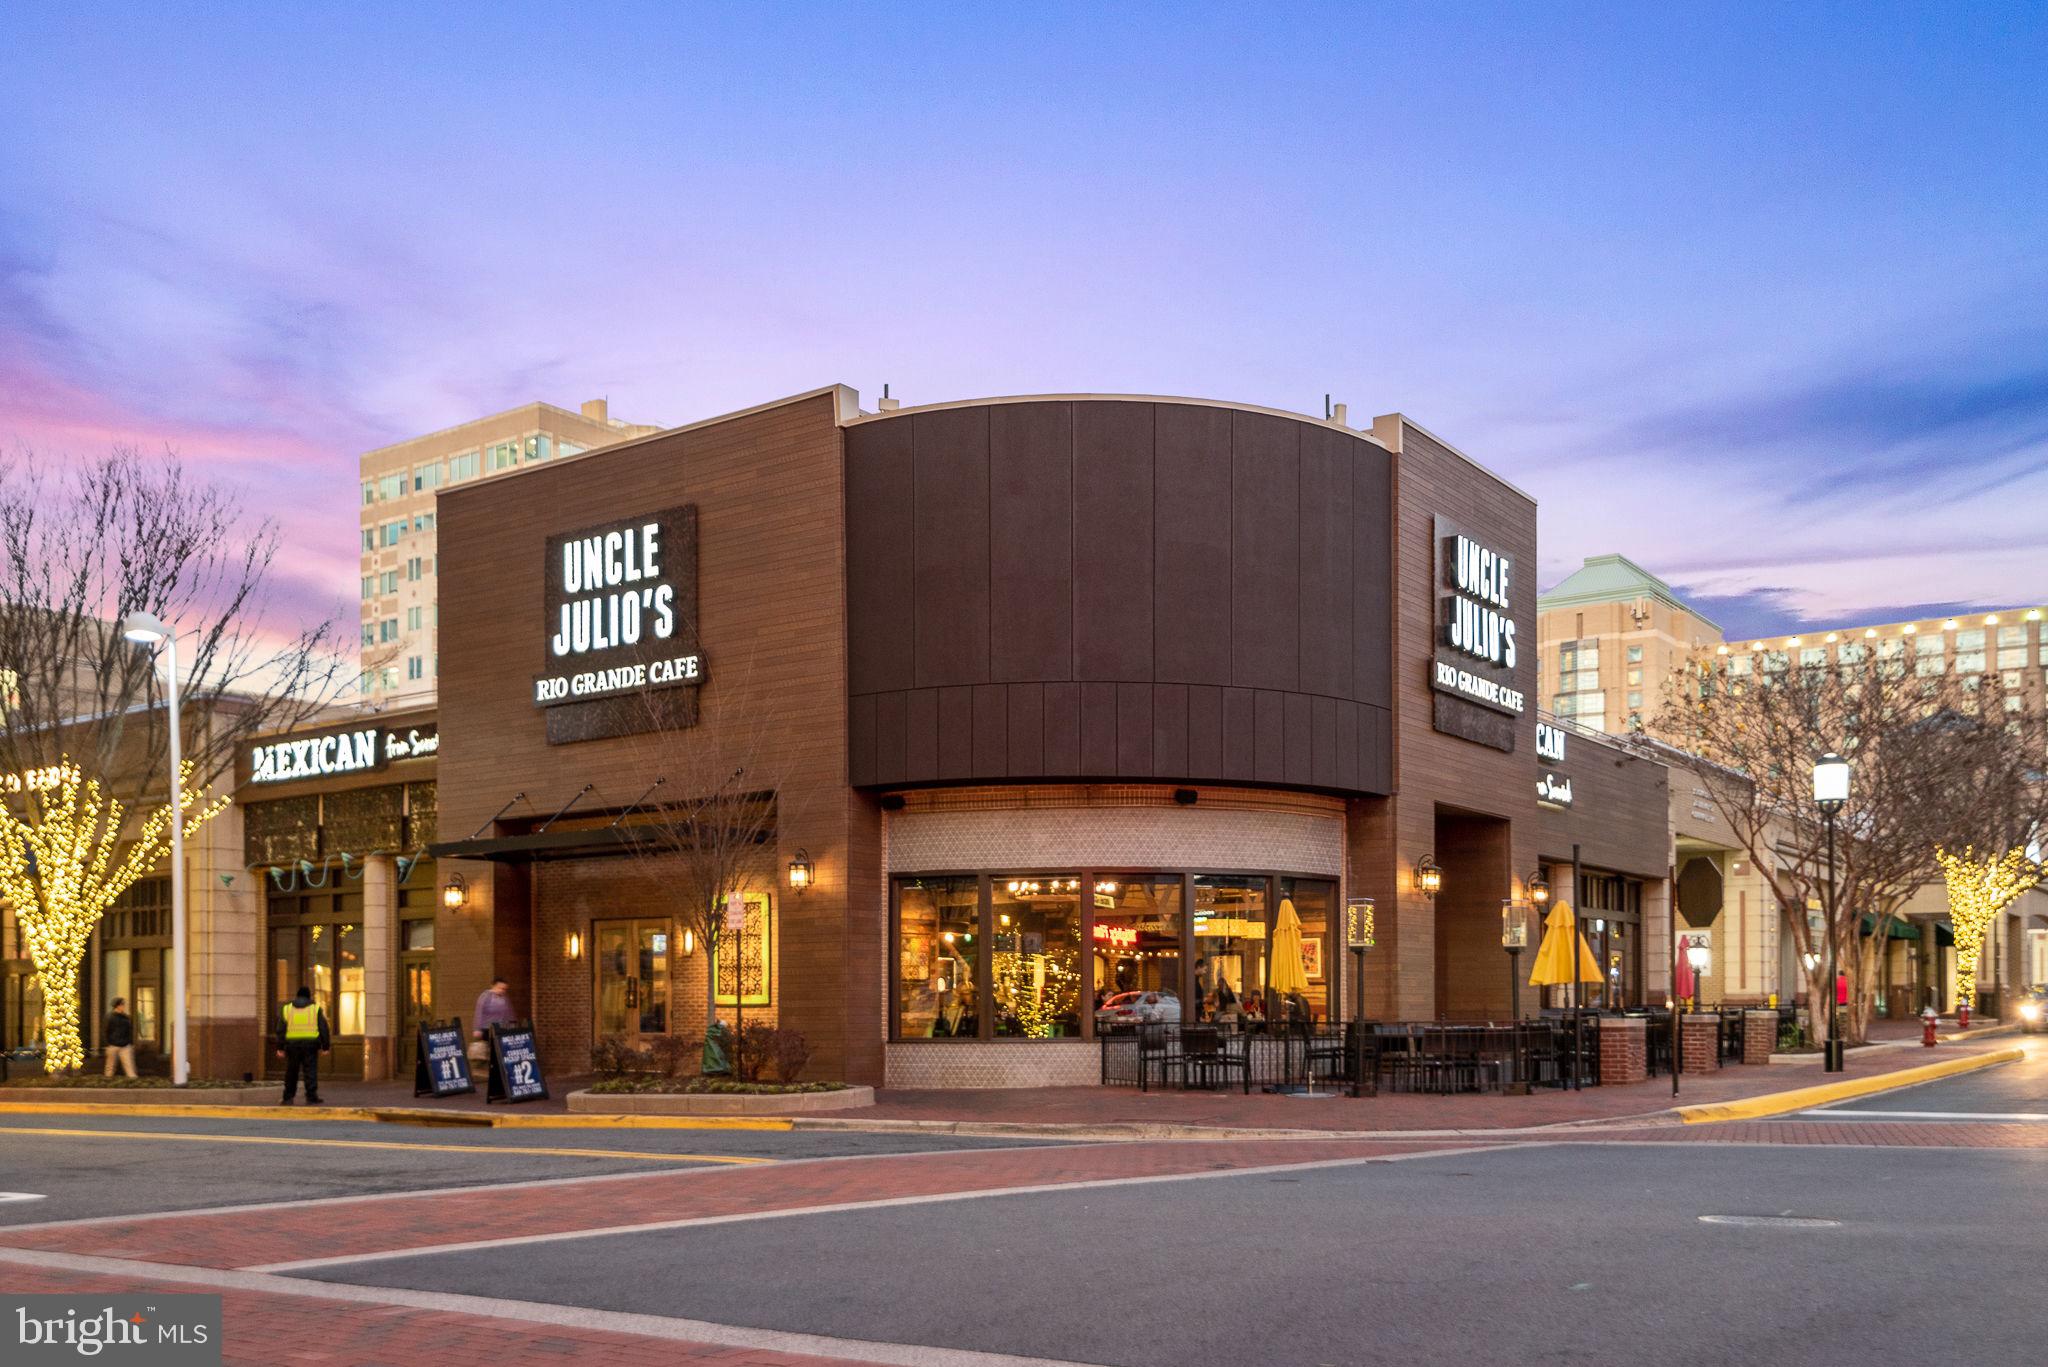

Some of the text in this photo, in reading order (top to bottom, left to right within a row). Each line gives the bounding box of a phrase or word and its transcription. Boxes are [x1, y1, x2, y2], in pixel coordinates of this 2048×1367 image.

[563, 523, 660, 594] UNCLE
[1456, 534, 1509, 609] UNCLE
[553, 584, 674, 656] JULIO'S
[1451, 595, 1516, 668] JULIO'S
[536, 655, 699, 701] RIO GRANDE CAFE
[1436, 661, 1524, 712] RIO GRANDE CAFE
[251, 729, 377, 783] MEXICAN
[441, 1056, 460, 1079] #1
[513, 1060, 535, 1085] #2
